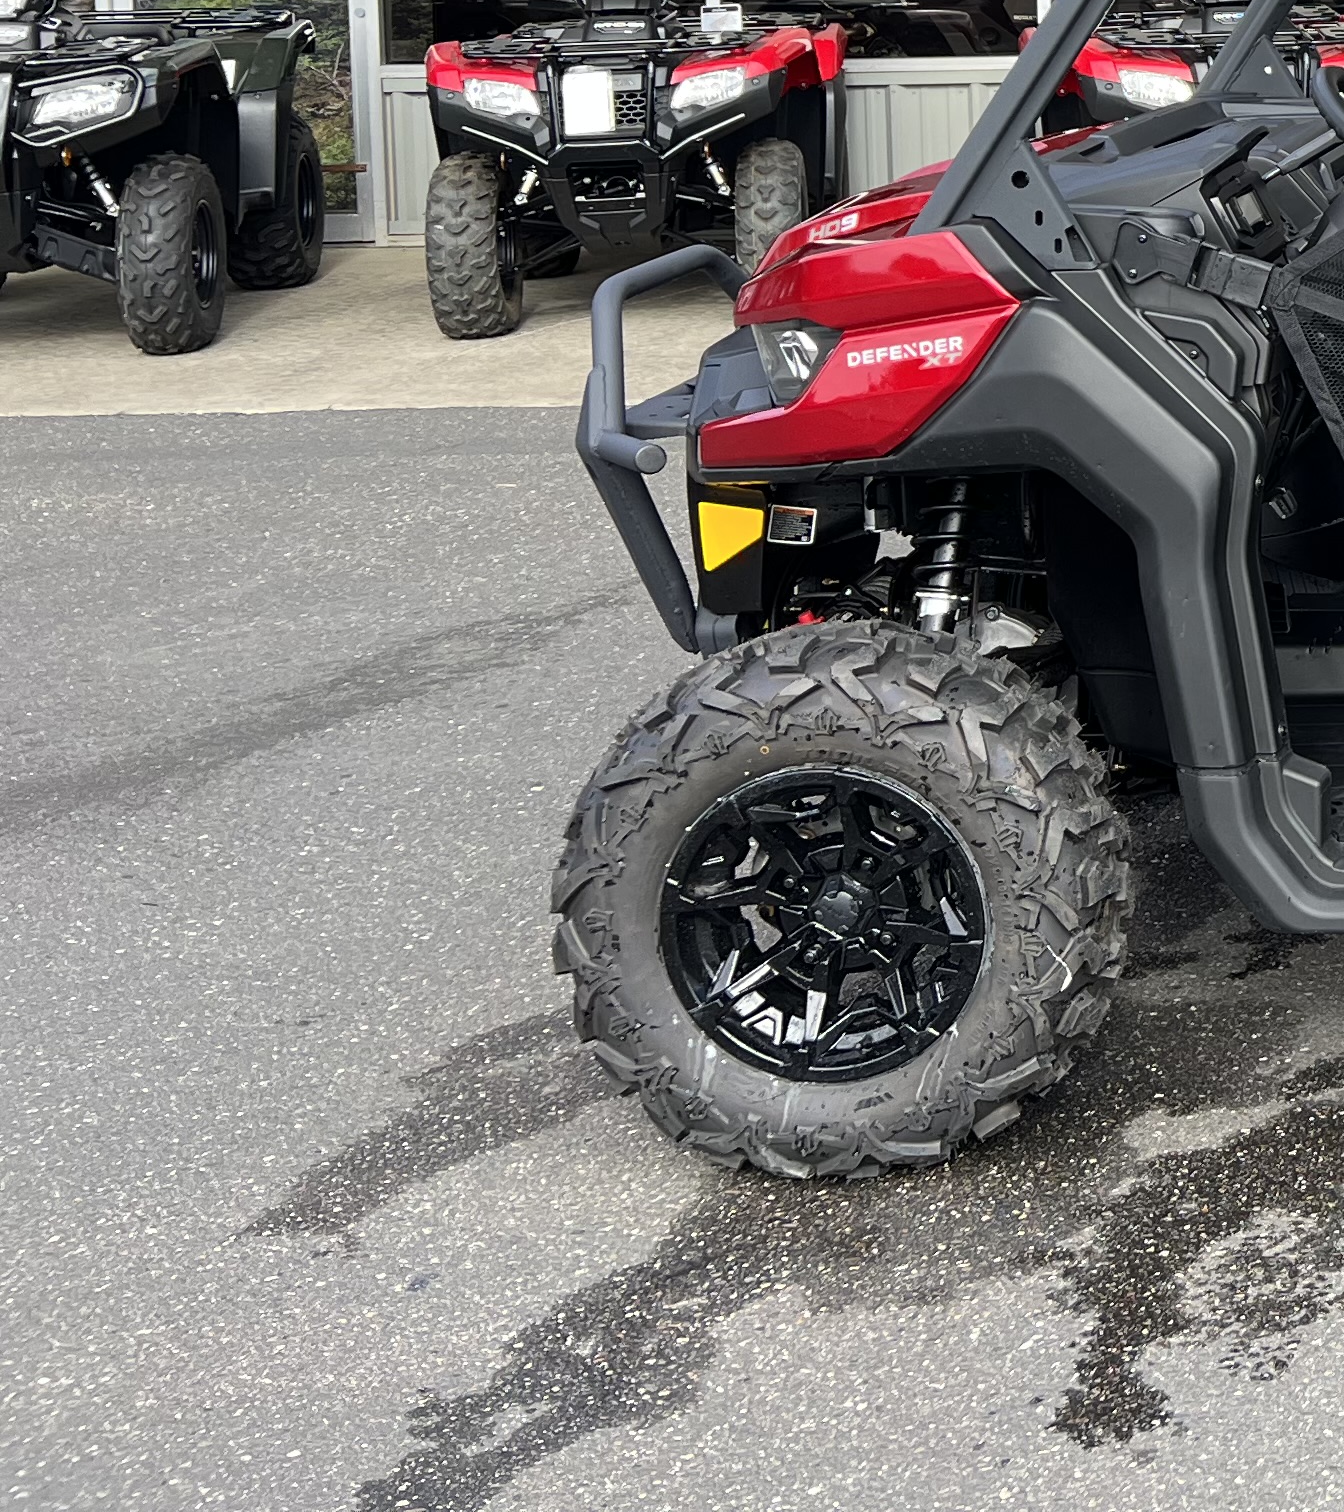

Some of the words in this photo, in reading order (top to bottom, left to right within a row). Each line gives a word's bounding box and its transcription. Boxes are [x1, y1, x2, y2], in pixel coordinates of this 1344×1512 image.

[808, 212, 860, 243] HD9
[846, 336, 964, 368] DEFENDER
[923, 352, 962, 368] XT
